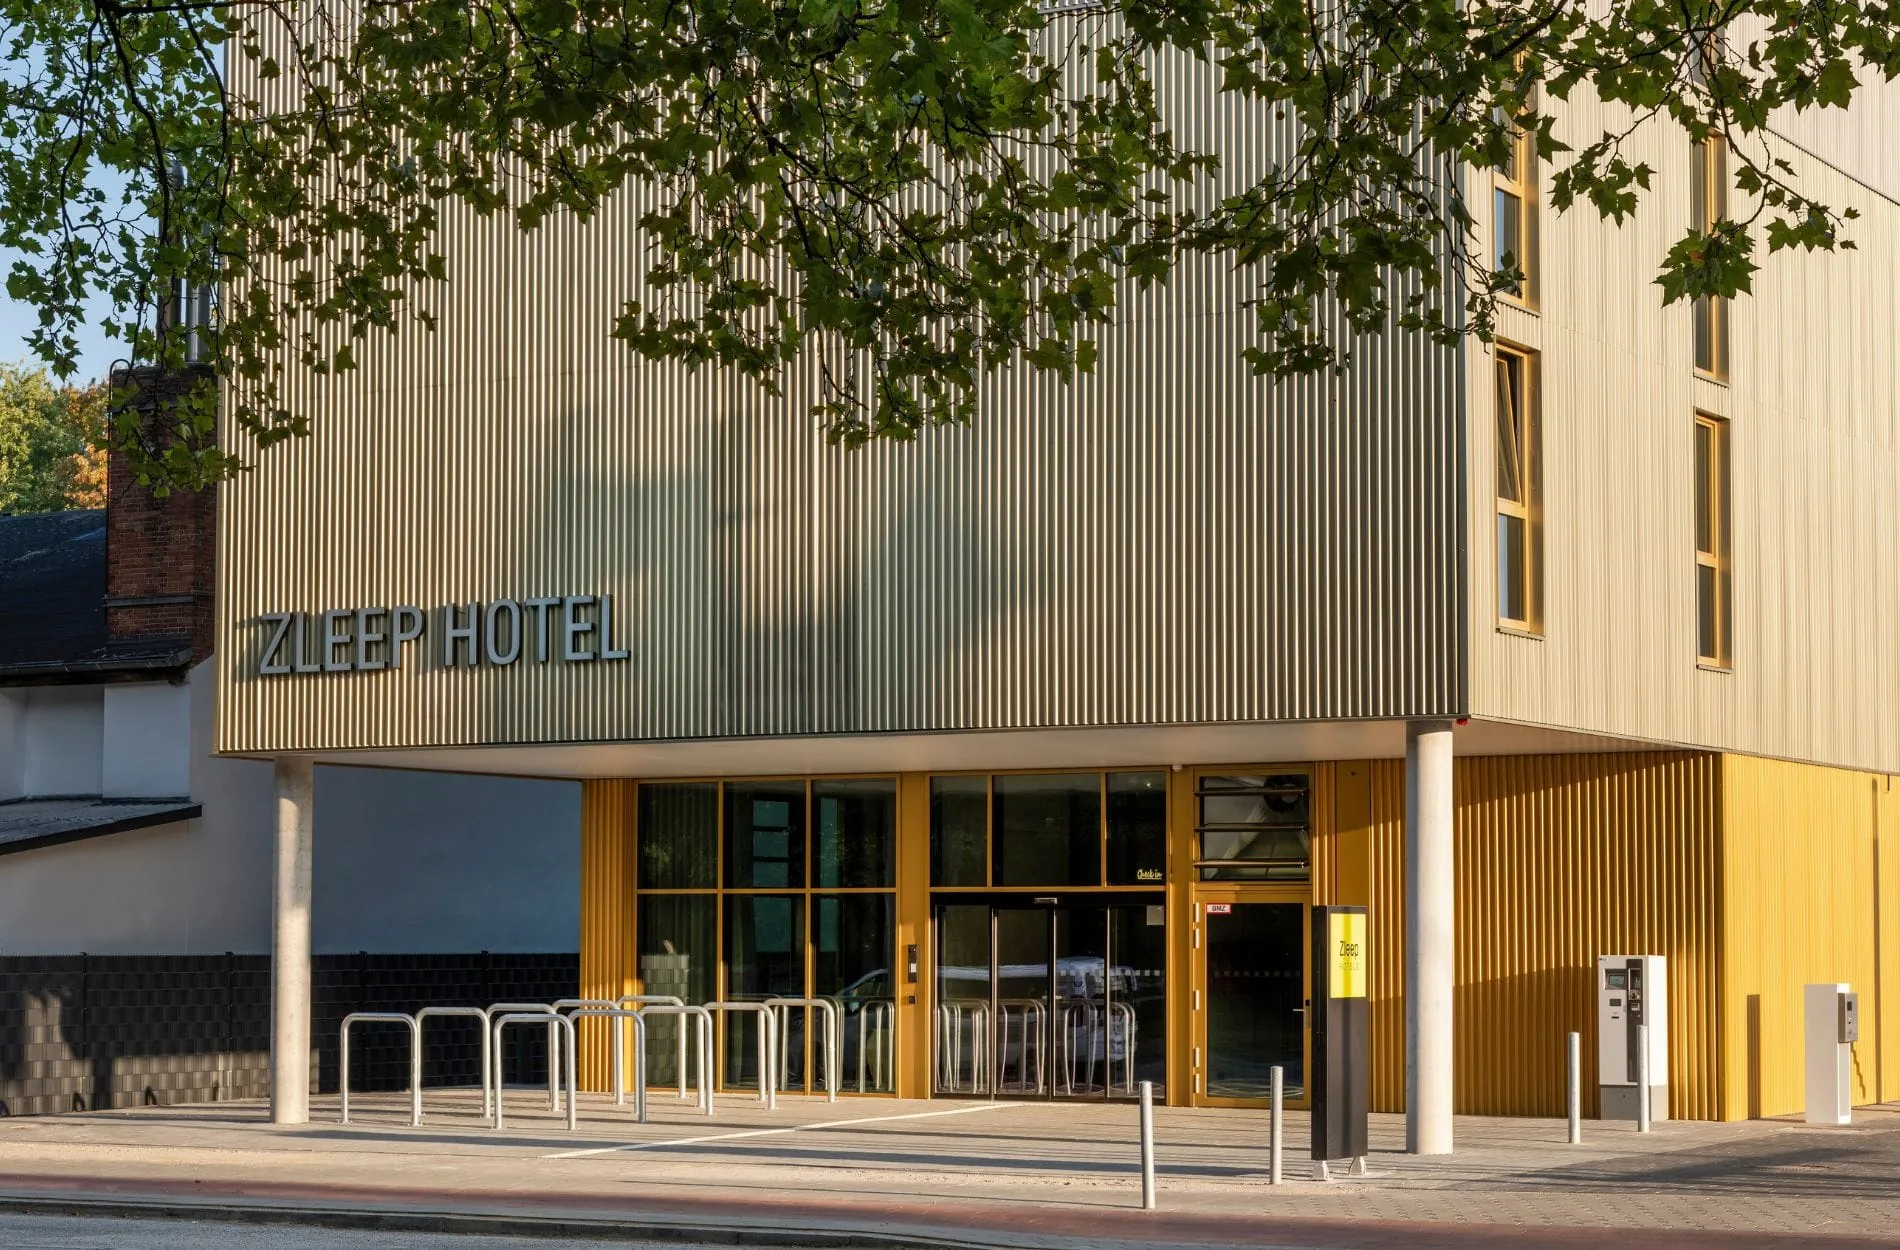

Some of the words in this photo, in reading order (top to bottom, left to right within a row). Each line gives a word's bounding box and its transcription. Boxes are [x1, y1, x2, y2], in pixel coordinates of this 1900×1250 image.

[258, 604, 425, 674] ZLEEP
[443, 593, 630, 667] HOTEL
[1339, 940, 1359, 960] Zleep
